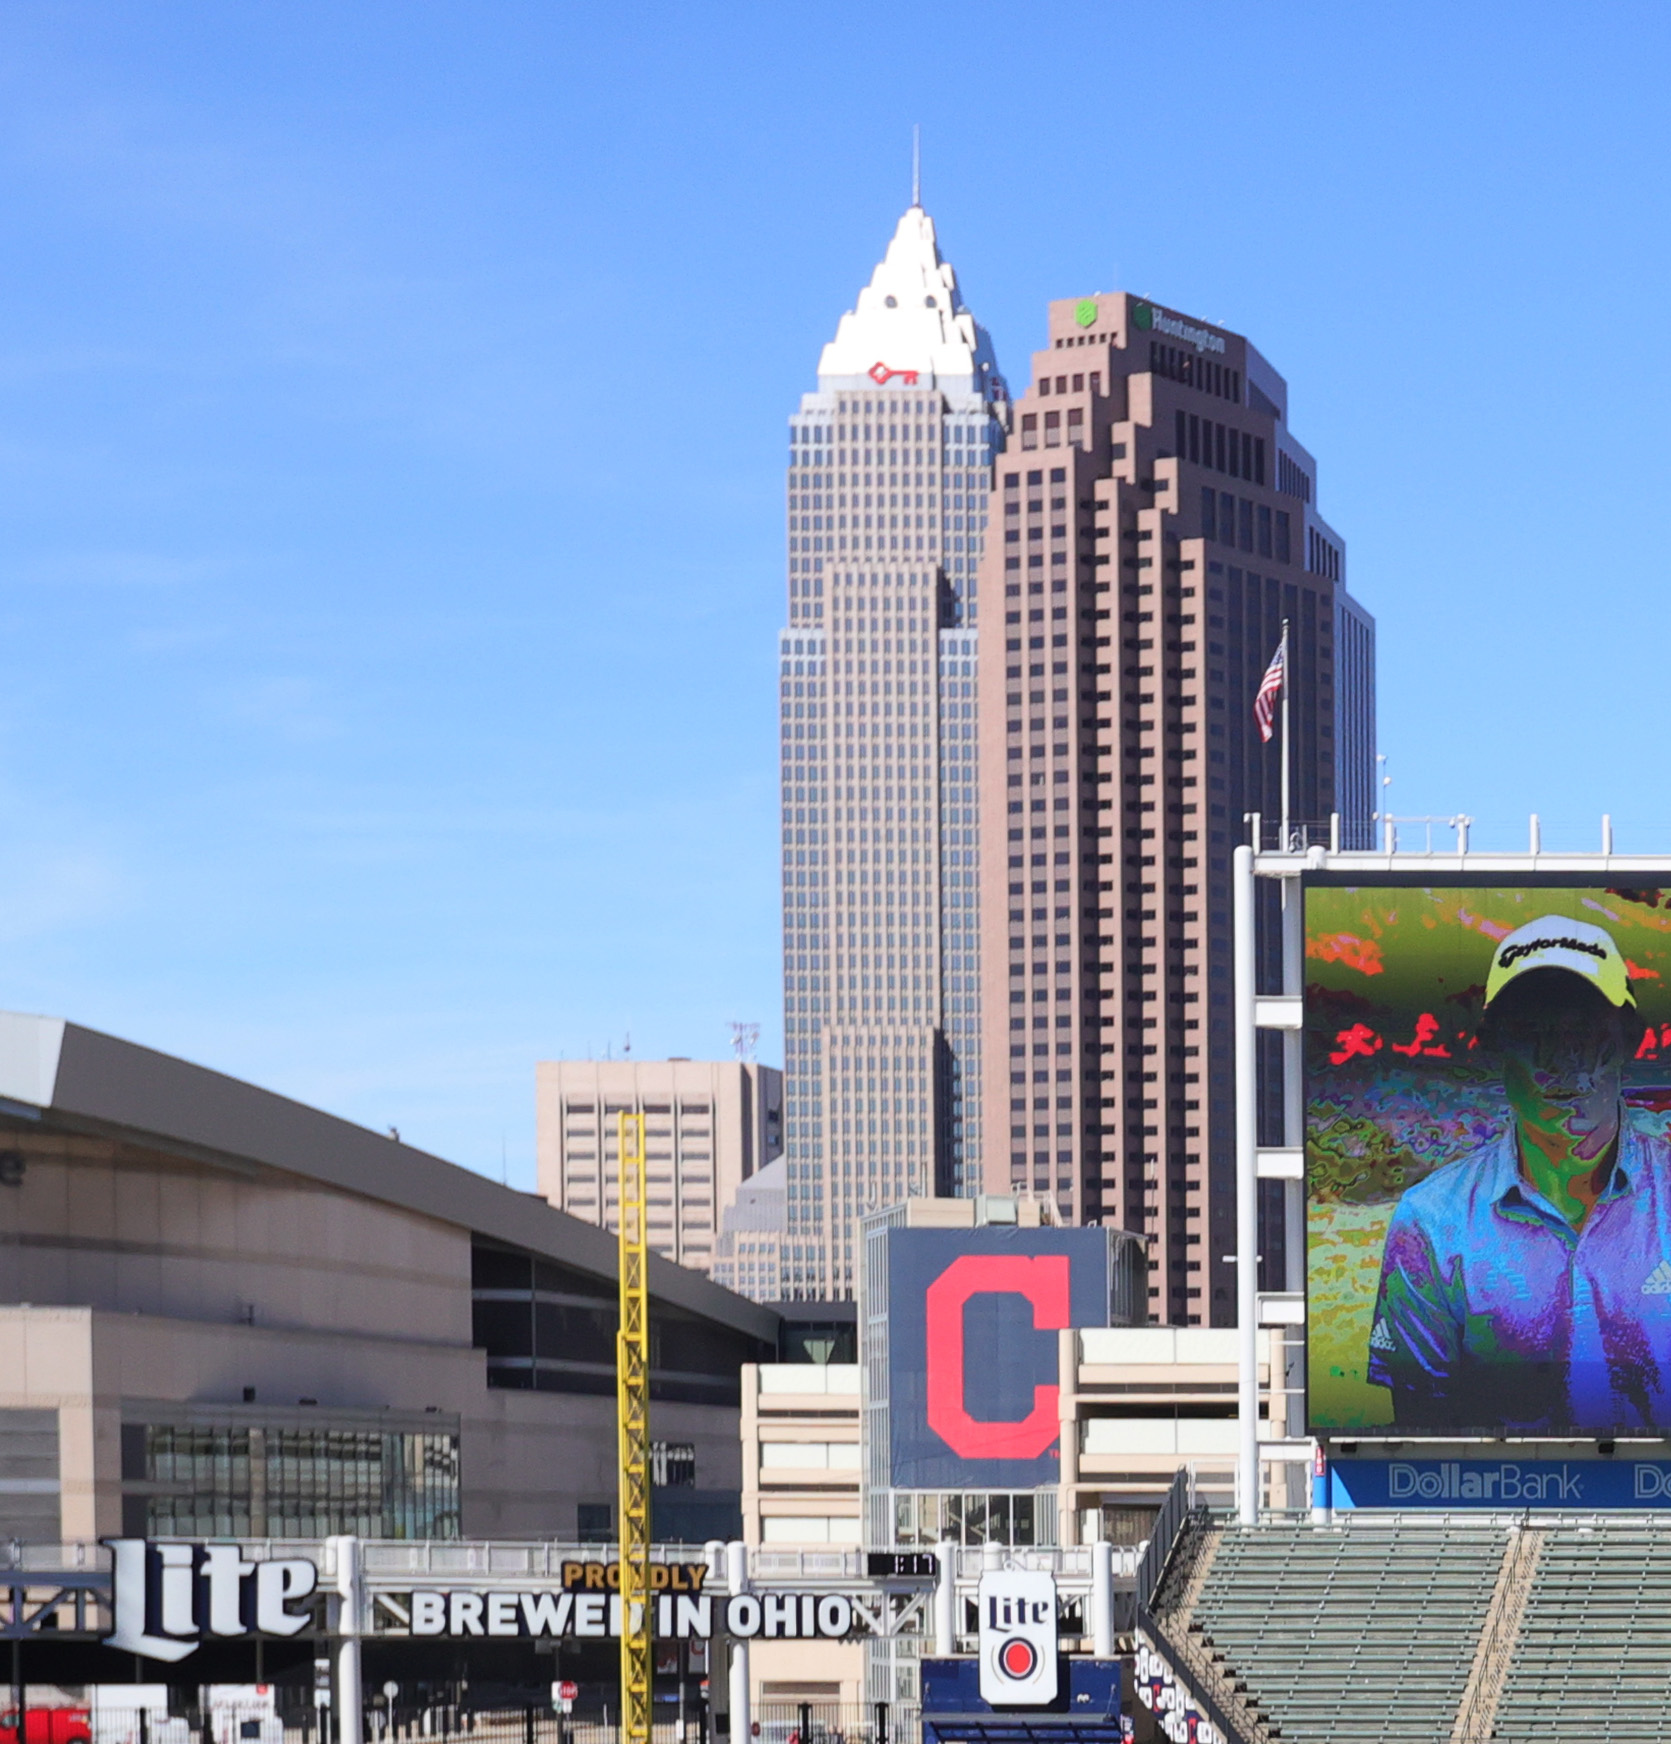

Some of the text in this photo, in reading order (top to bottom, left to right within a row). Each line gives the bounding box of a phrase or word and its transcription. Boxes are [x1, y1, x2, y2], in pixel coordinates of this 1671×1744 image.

[1151, 306, 1226, 355] Huntington
[1498, 936, 1608, 969] TaylorMade
[1388, 1463, 1582, 1500] DollarBank
[564, 1563, 710, 1590] PRODLY
[102, 1537, 318, 1663] Lite
[658, 1594, 712, 1638] IN
[727, 1593, 852, 1638] OHIO
[987, 1595, 1050, 1633] Lite
